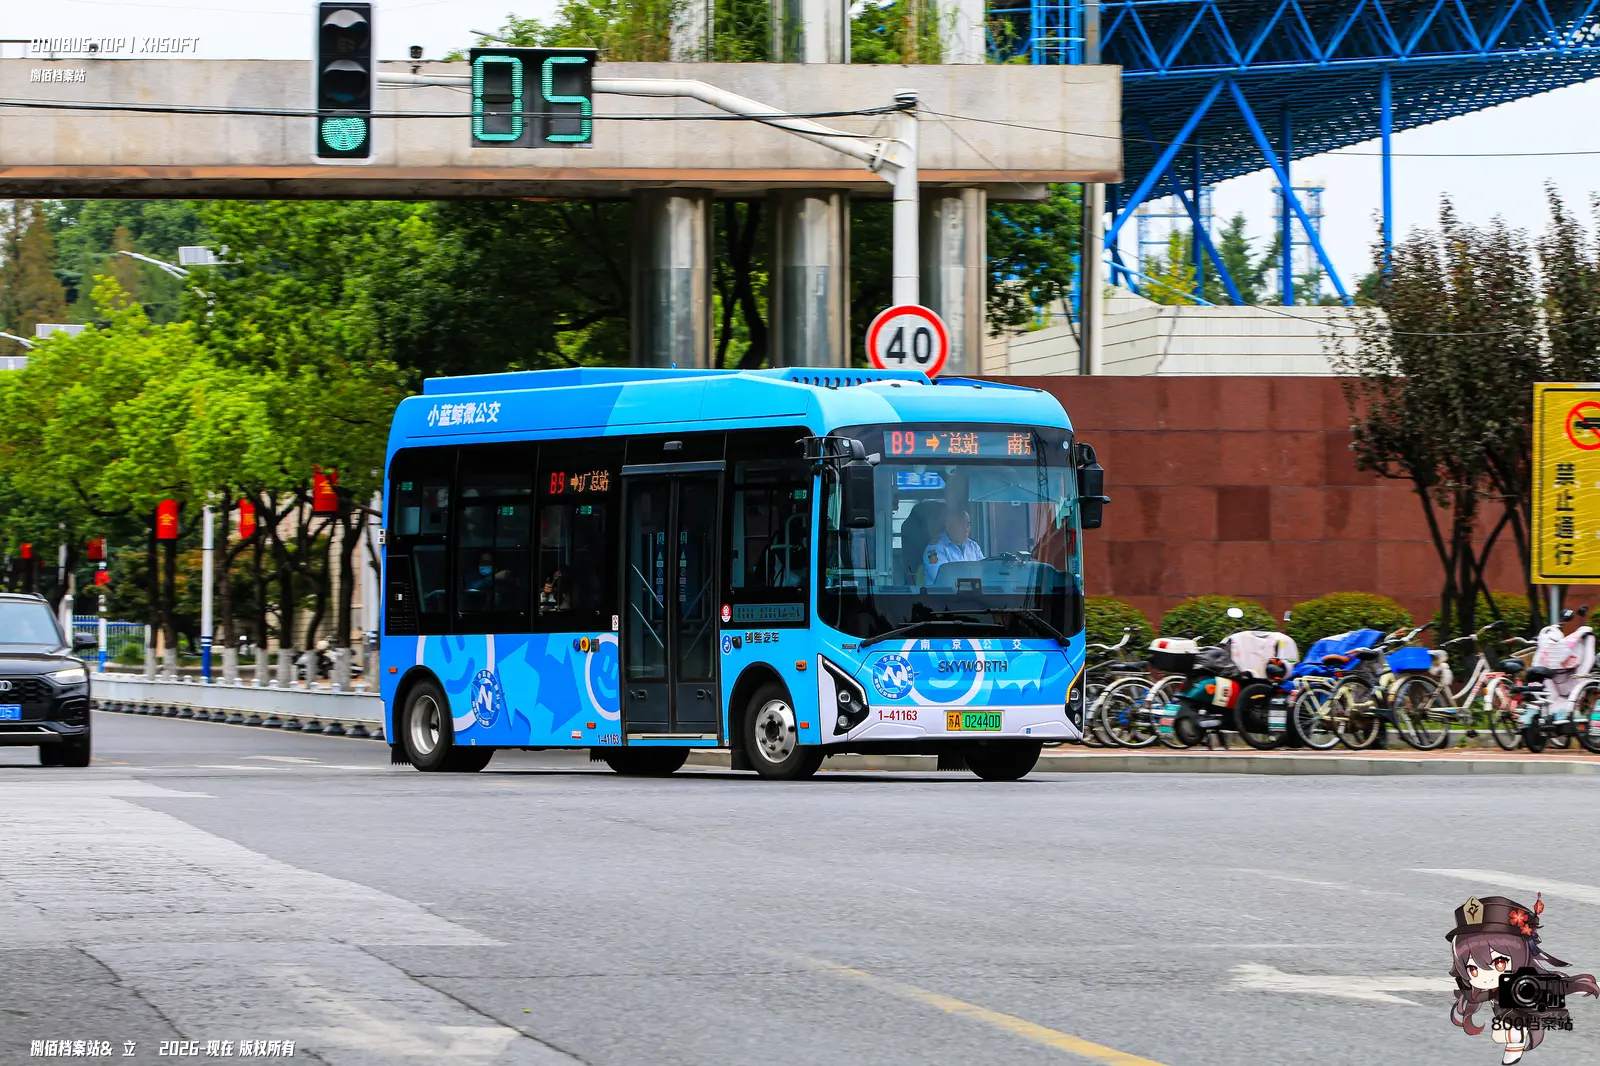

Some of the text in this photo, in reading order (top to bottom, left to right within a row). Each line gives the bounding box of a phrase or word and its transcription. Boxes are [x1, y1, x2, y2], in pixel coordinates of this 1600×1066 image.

[472, 55, 592, 142] 05
[885, 326, 932, 364] 40
[427, 401, 501, 427] 小蓝鲸微公交
[891, 431, 915, 455] B9
[940, 432, 979, 454] 总站
[550, 472, 565, 494] B9
[920, 639, 1022, 650] 南京公交
[938, 660, 1008, 672] SKYWORTH
[878, 710, 918, 721] 1-41163
[597, 733, 620, 745] 1-41163
